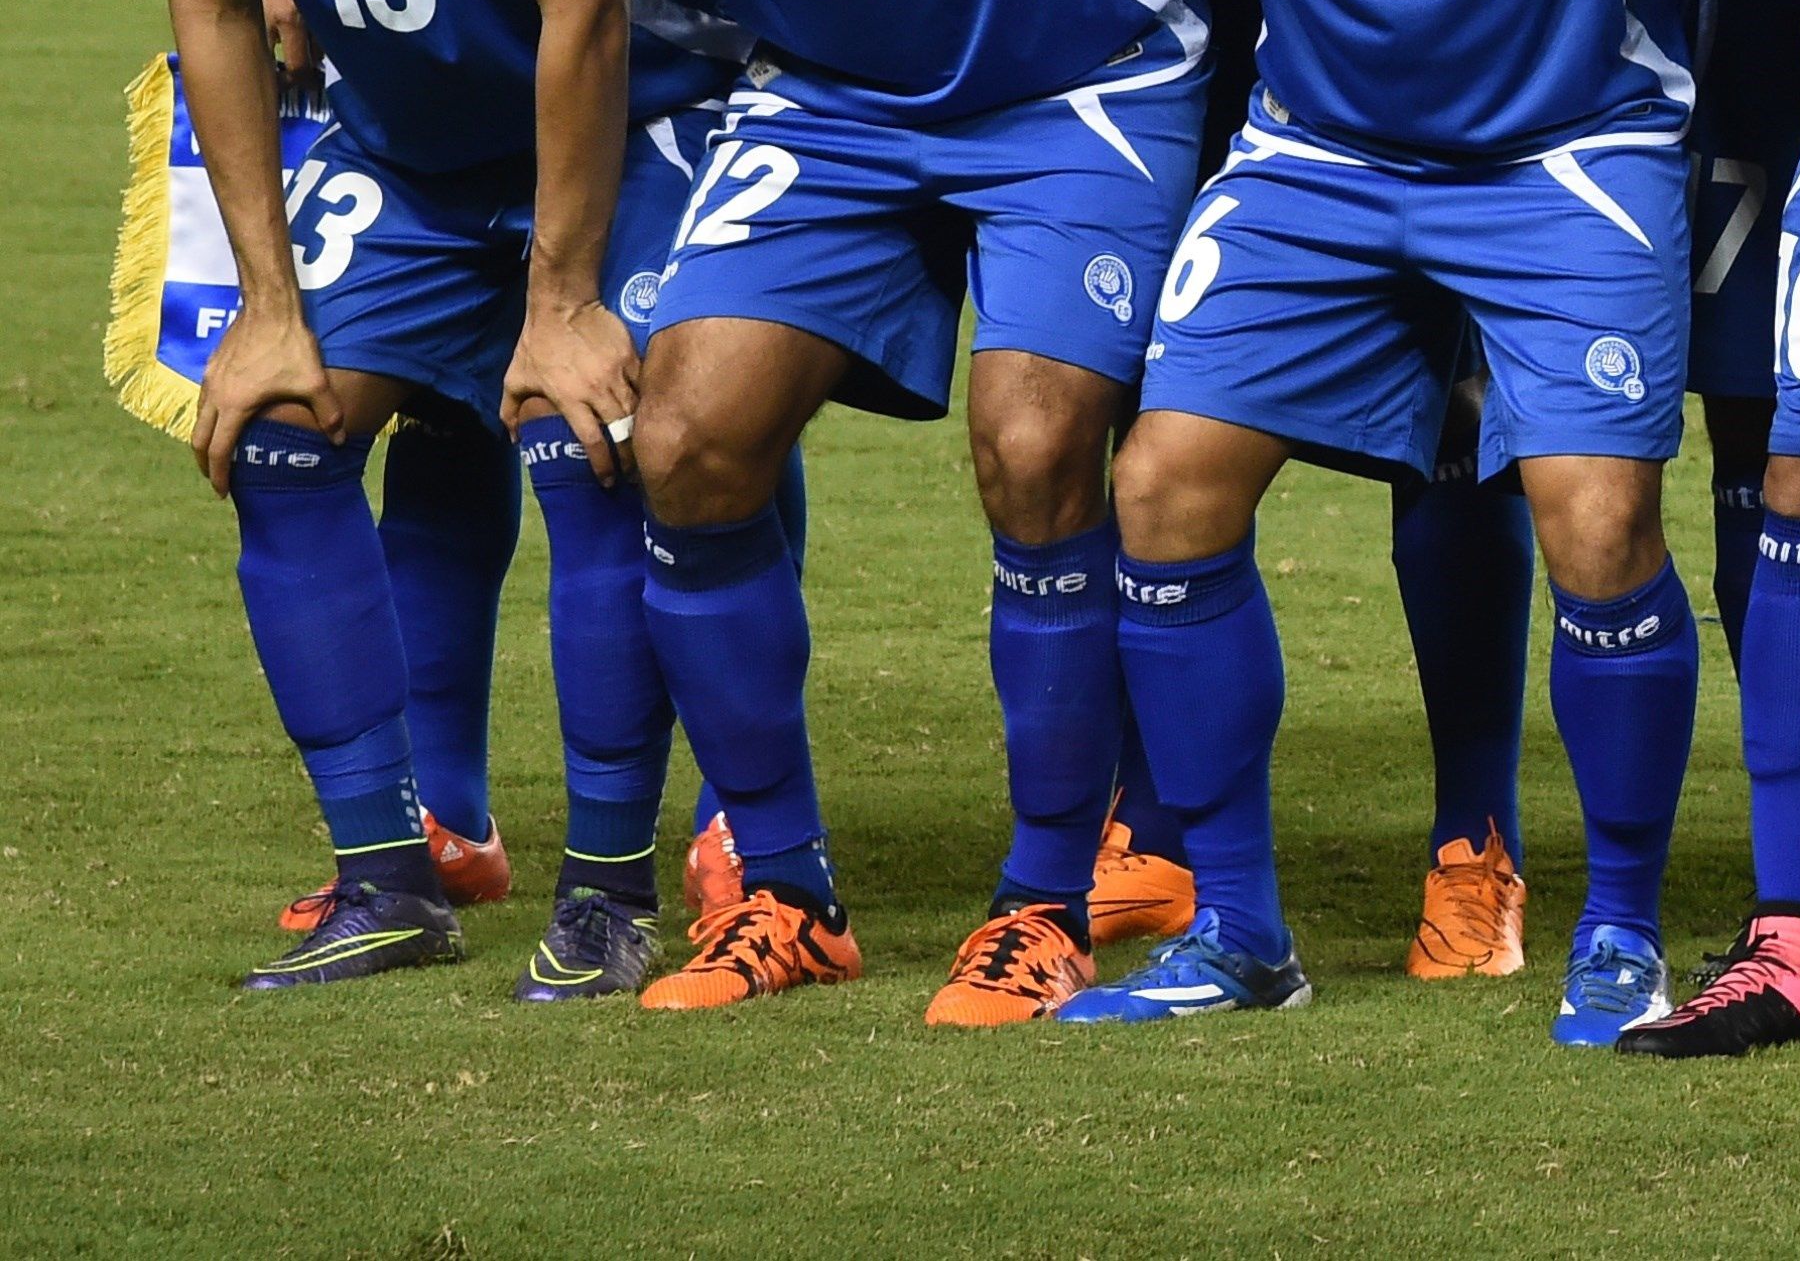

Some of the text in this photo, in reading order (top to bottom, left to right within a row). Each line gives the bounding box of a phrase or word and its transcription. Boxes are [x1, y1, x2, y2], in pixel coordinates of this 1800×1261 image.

[673, 140, 801, 252] 12
[1159, 194, 1241, 322] 6
[1560, 615, 1661, 649] mitre
